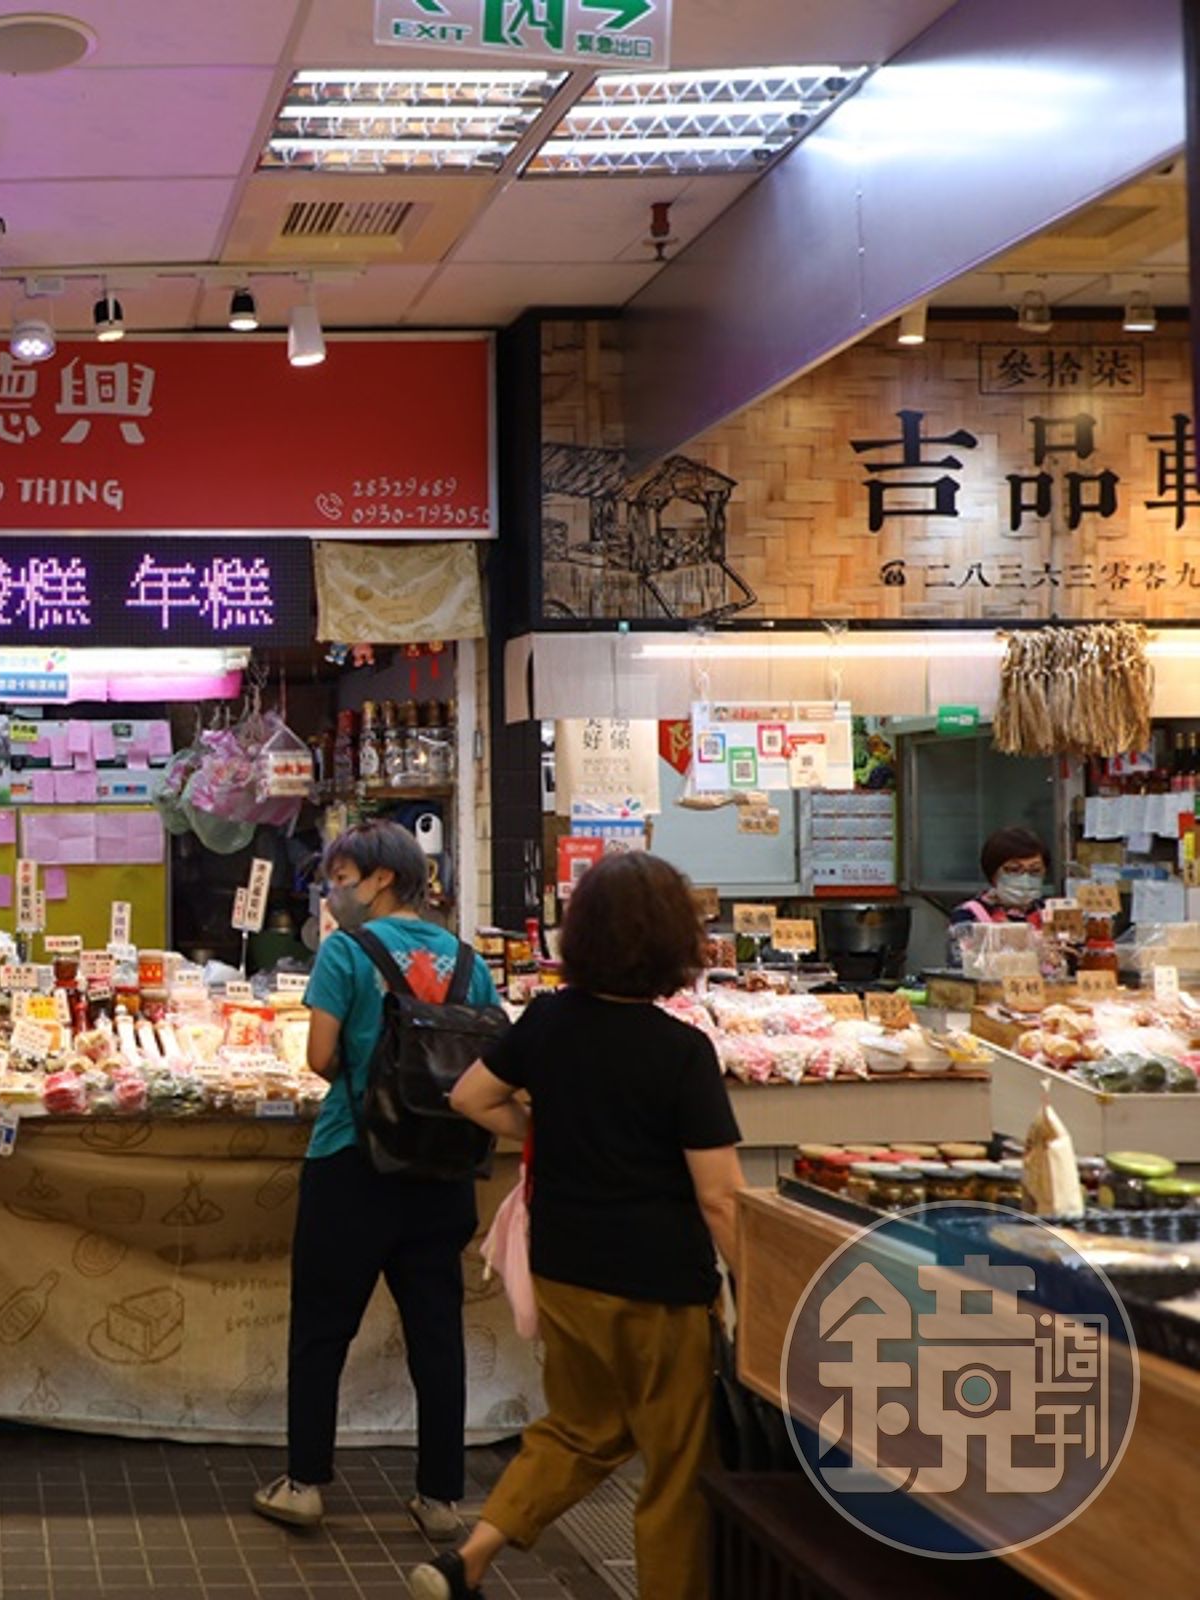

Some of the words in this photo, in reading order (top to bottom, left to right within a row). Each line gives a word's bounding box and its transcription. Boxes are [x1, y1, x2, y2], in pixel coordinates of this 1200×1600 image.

[393, 21, 471, 41] EXIT
[576, 33, 652, 58] 緊急出口
[17, 478, 125, 511] THING
[125, 554, 274, 629] 年糕
